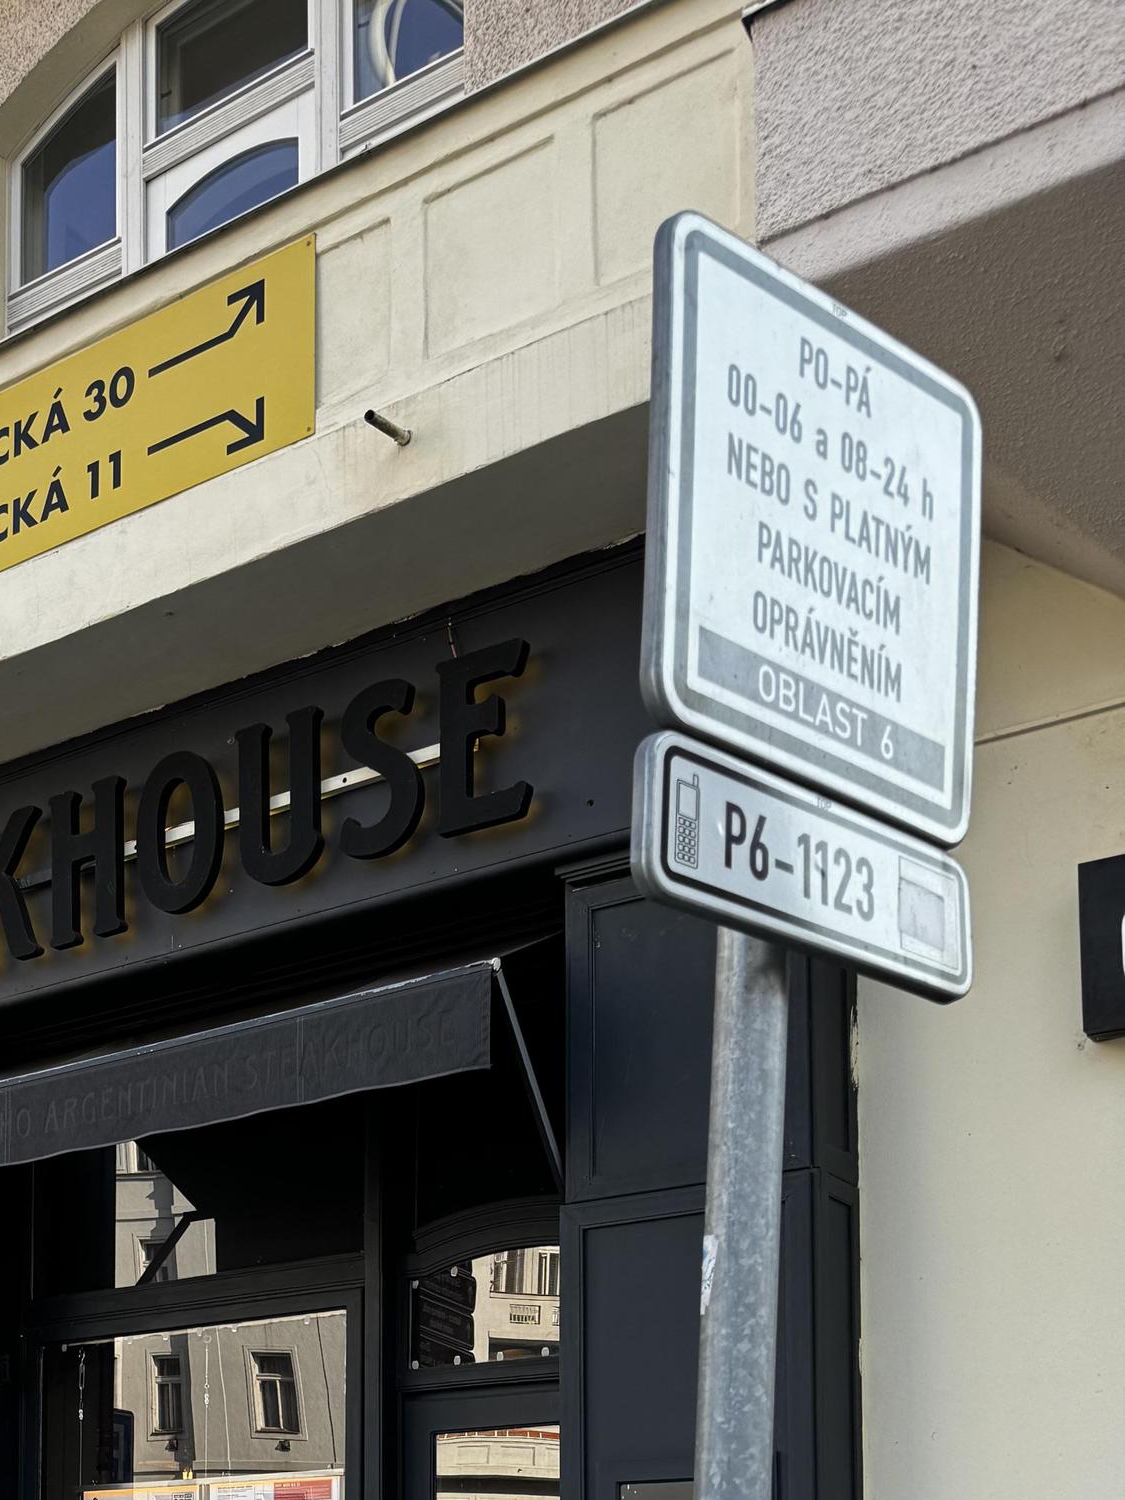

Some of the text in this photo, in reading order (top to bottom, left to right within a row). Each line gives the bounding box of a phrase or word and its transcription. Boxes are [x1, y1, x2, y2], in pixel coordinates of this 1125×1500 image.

[84, 366, 135, 423] 30
[799, 336, 872, 419] PO-PÁ
[86, 450, 123, 500] 11
[727, 364, 934, 522] 00-06 a 08-24 h
[727, 432, 932, 586] NEBO S PLATNÝM
[757, 521, 901, 636] PARKOVACÍM
[752, 590, 903, 703] OPRÁVNĚNÍM
[758, 664, 894, 760] OBLAST 6
[724, 800, 875, 923] P6-1123
[44, 1060, 229, 1135] ARGENTINIAN
[242, 1009, 459, 1093] STEAKHOUSE
